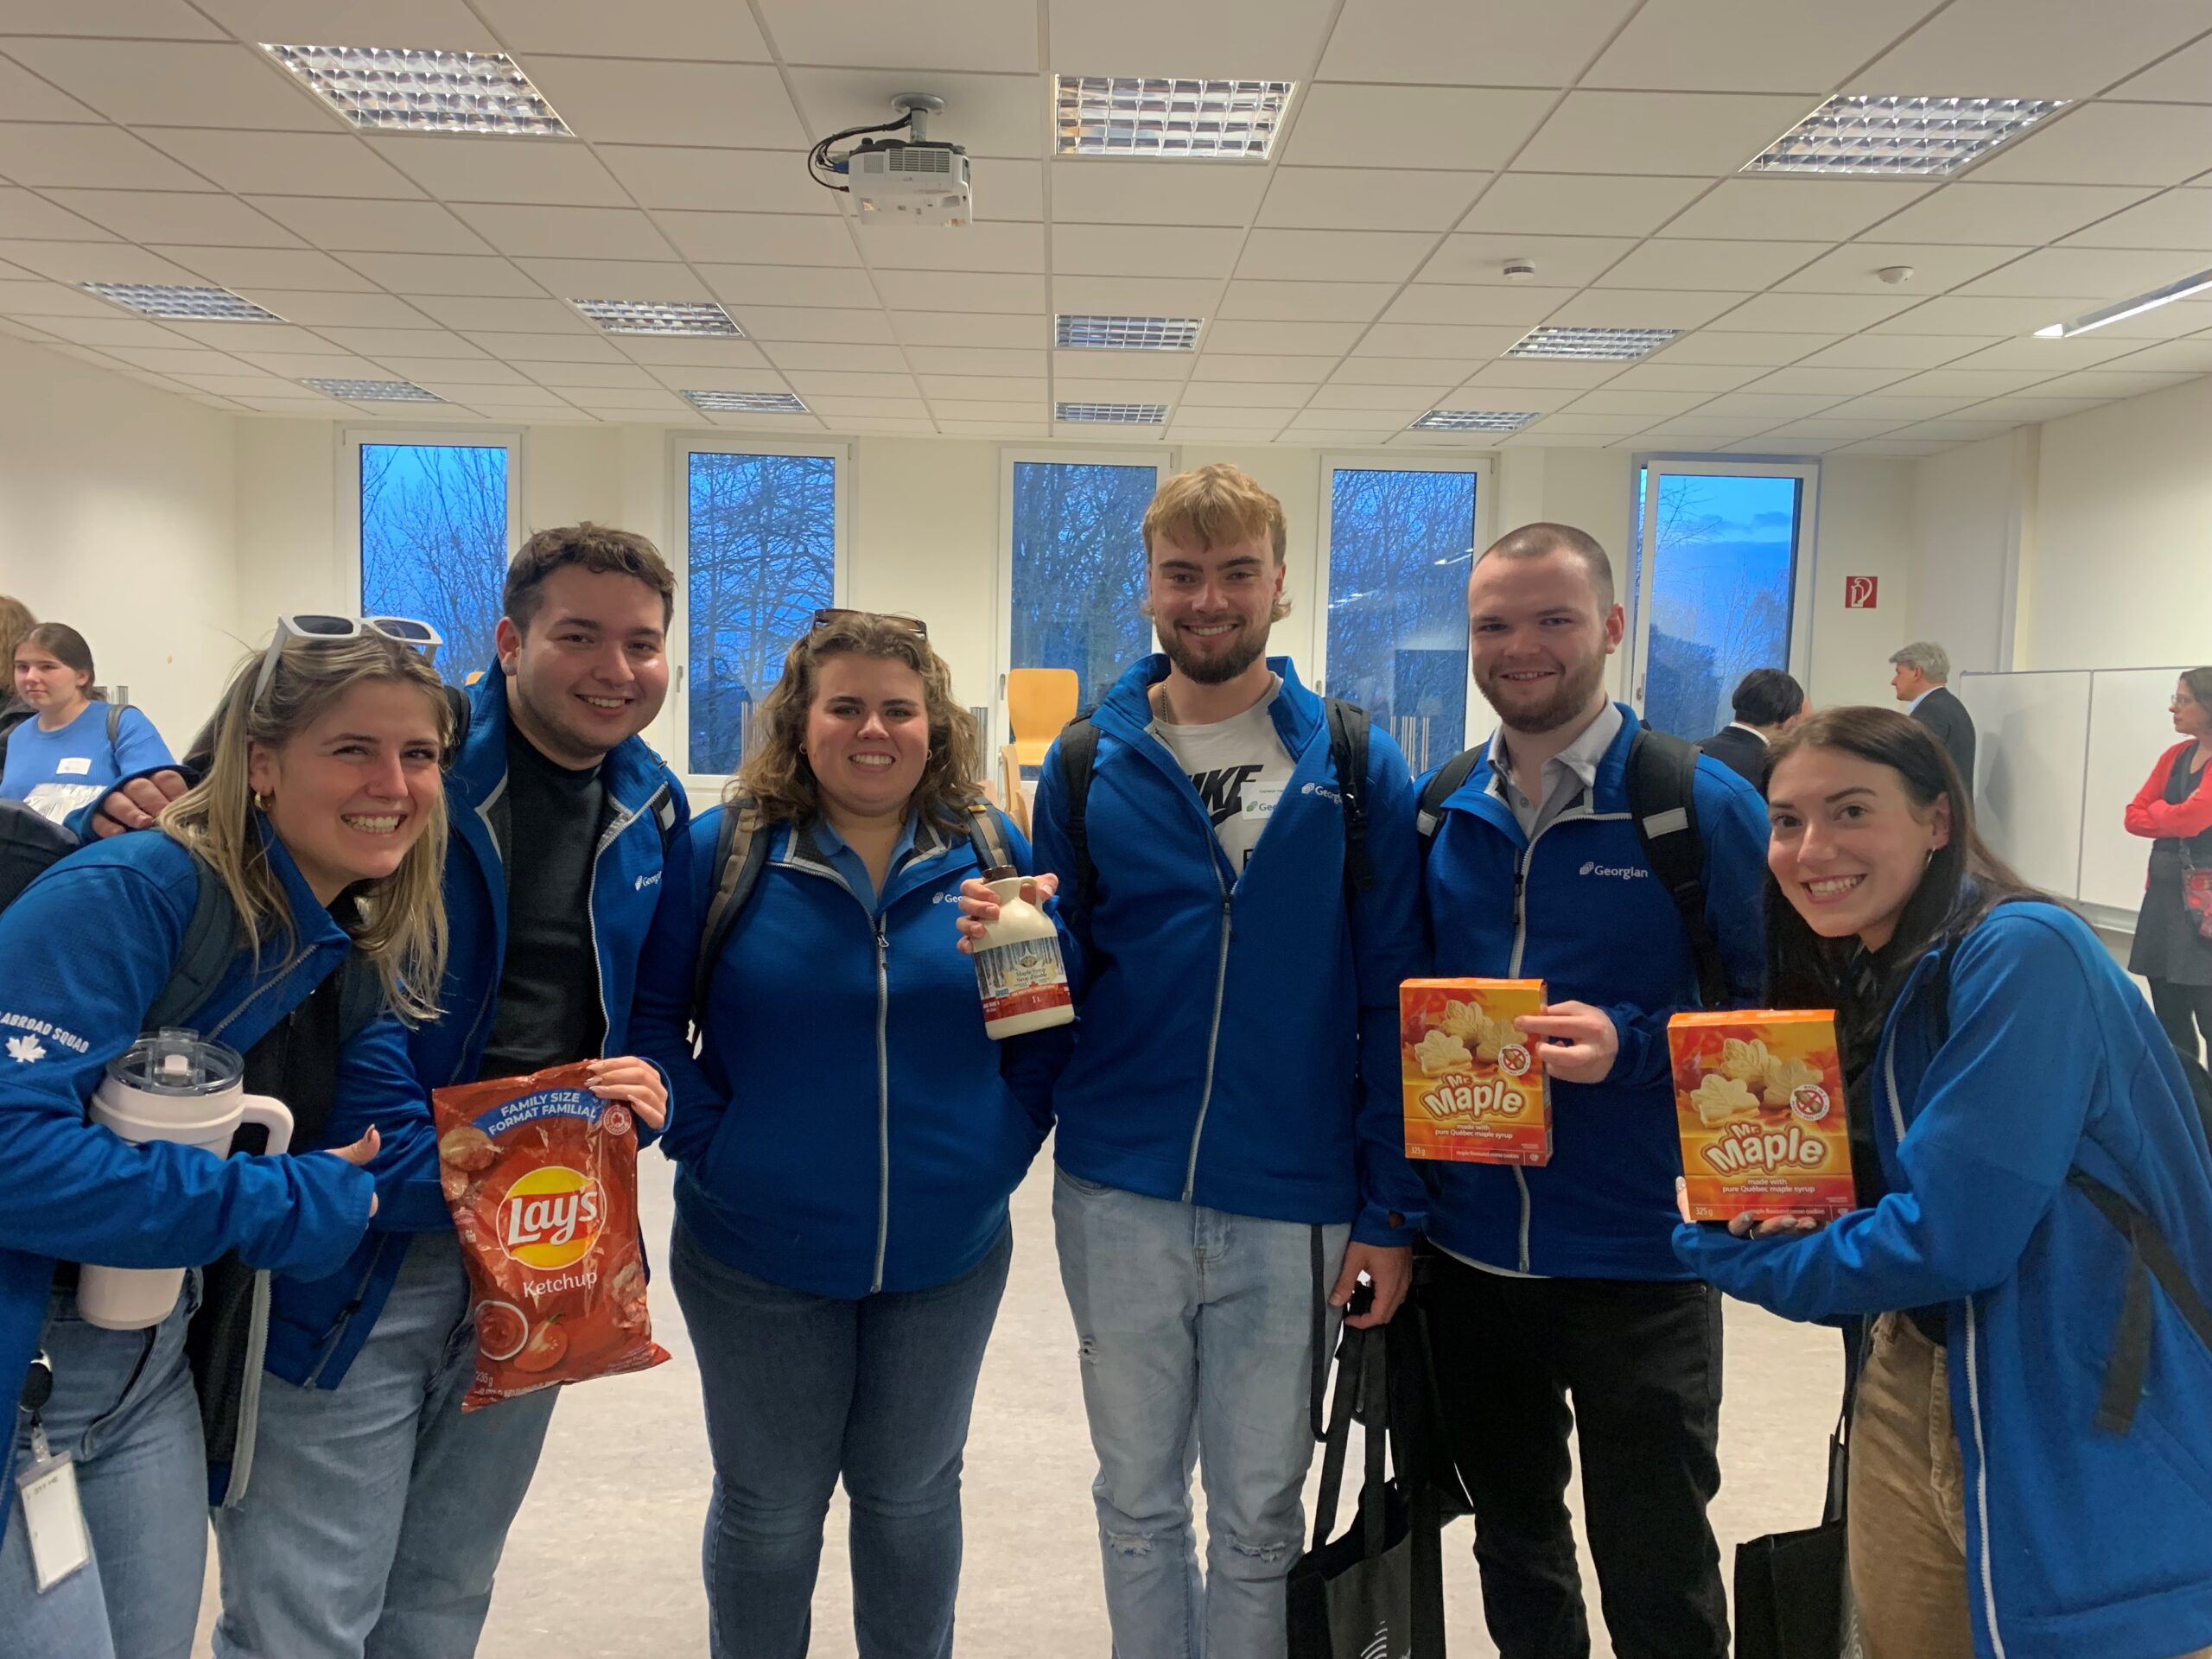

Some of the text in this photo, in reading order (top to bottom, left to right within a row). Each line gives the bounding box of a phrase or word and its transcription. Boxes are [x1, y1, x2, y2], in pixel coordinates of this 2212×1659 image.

[1187, 764, 1265, 812] IKE
[1594, 865, 1649, 880] Georgian
[1, 1012, 90, 1053] ABROAD SQUAD
[1446, 1075, 1470, 1089] Mr.
[500, 1091, 580, 1117] FAMILY SIZE
[1423, 1080, 1523, 1117] Maple
[488, 1106, 538, 1135] FORMAT
[542, 1103, 597, 1118] FAMILIAL
[1731, 1123, 1761, 1139] Mr.
[1707, 1128, 1825, 1171] Maple
[1740, 1185, 1768, 1193] Québec
[1769, 1185, 1793, 1194] maple
[1794, 1185, 1815, 1194] syrup
[508, 1185, 598, 1246] Lay's
[1695, 1206, 1713, 1217] 325 g
[523, 1271, 598, 1298] Ketchup
